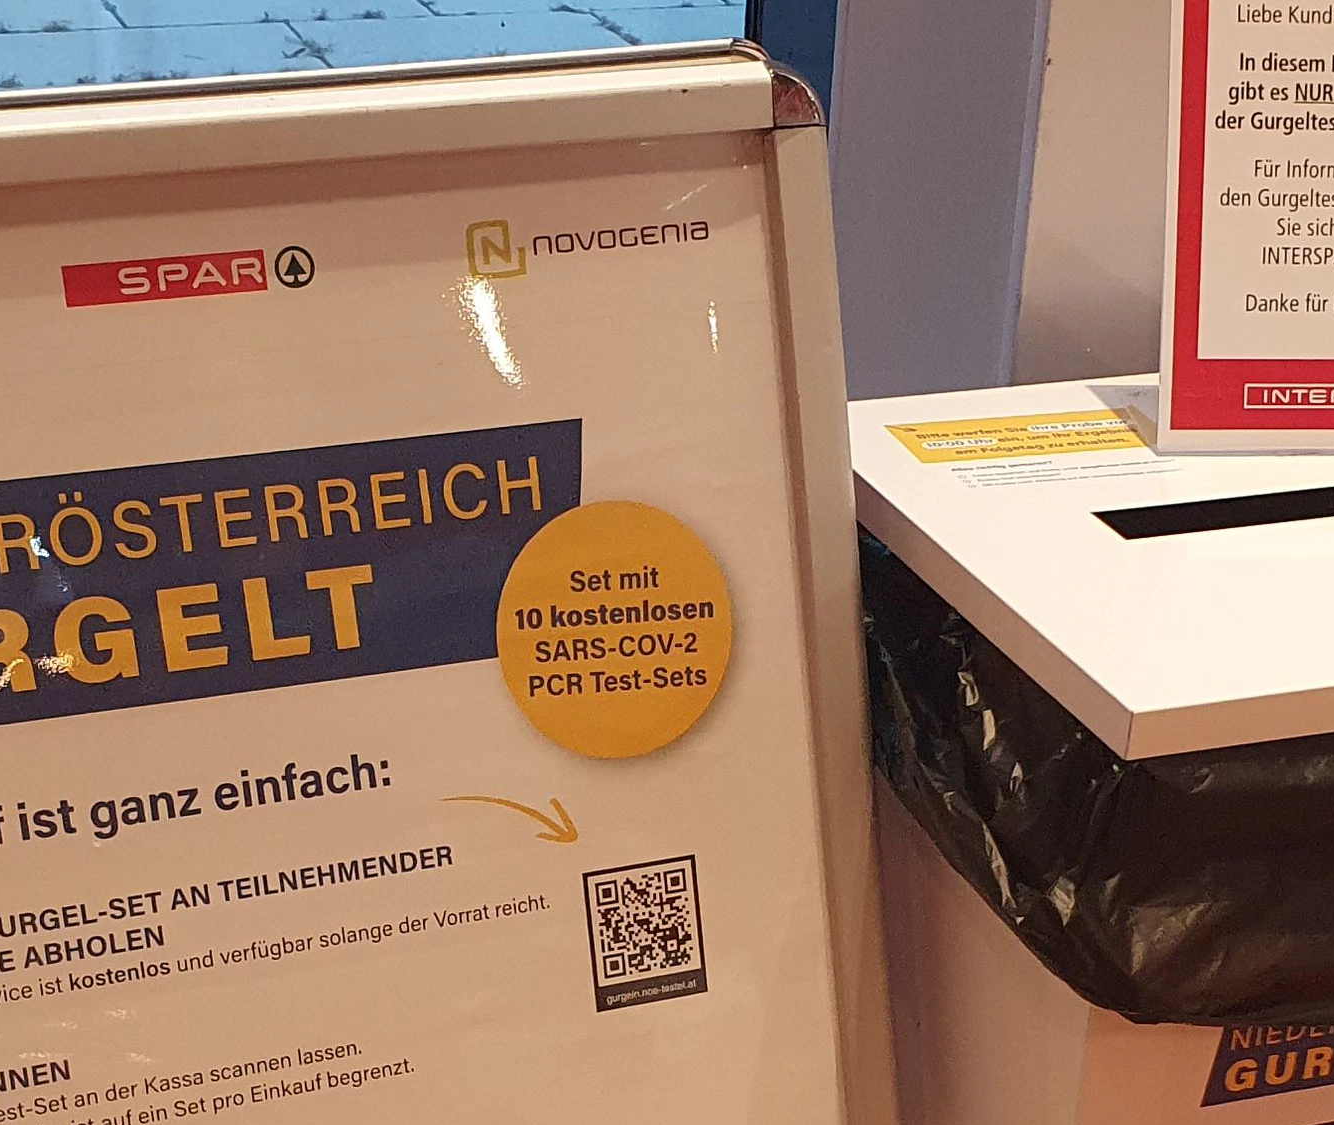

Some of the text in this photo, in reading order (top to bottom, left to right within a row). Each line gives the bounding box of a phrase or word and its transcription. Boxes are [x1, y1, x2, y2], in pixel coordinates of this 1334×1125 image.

[1238, 3, 1282, 23] Liebe
[1240, 52, 1255, 71] In
[1262, 52, 1325, 72] diesem
[1229, 84, 1263, 103] gibt
[1270, 88, 1289, 100] es
[1295, 84, 1334, 102] NUR
[1215, 109, 1245, 129] der
[1254, 159, 1281, 177] Für
[1220, 187, 1250, 206] den
[1277, 217, 1301, 236] Sie
[117, 257, 263, 295] SPAR
[1246, 293, 1299, 312] Danke
[1306, 293, 1328, 312] für
[569, 566, 659, 592] Set mit
[514, 600, 714, 630] 10 kostenlosen
[535, 633, 697, 662] SARS-COV-2
[528, 667, 708, 697] PCR Test-Sets
[17, 800, 77, 841] ist
[90, 788, 201, 839] ganz
[214, 754, 390, 810] einfach:
[171, 883, 210, 910] AN
[216, 846, 452, 901] TEILNEHMENDER
[24, 925, 164, 969] ABHOLEN
[74, 1092, 98, 1107] an
[105, 1083, 137, 1101] der
[144, 1072, 203, 1094] Kassa
[210, 1056, 291, 1082] scannen
[297, 1043, 362, 1065] lassen.
[138, 1105, 167, 1124] ein
[174, 1097, 207, 1117] Set
[212, 1093, 244, 1114] pro
[250, 1073, 321, 1103] Einkauf
[326, 1058, 414, 1088] begrenzt.
